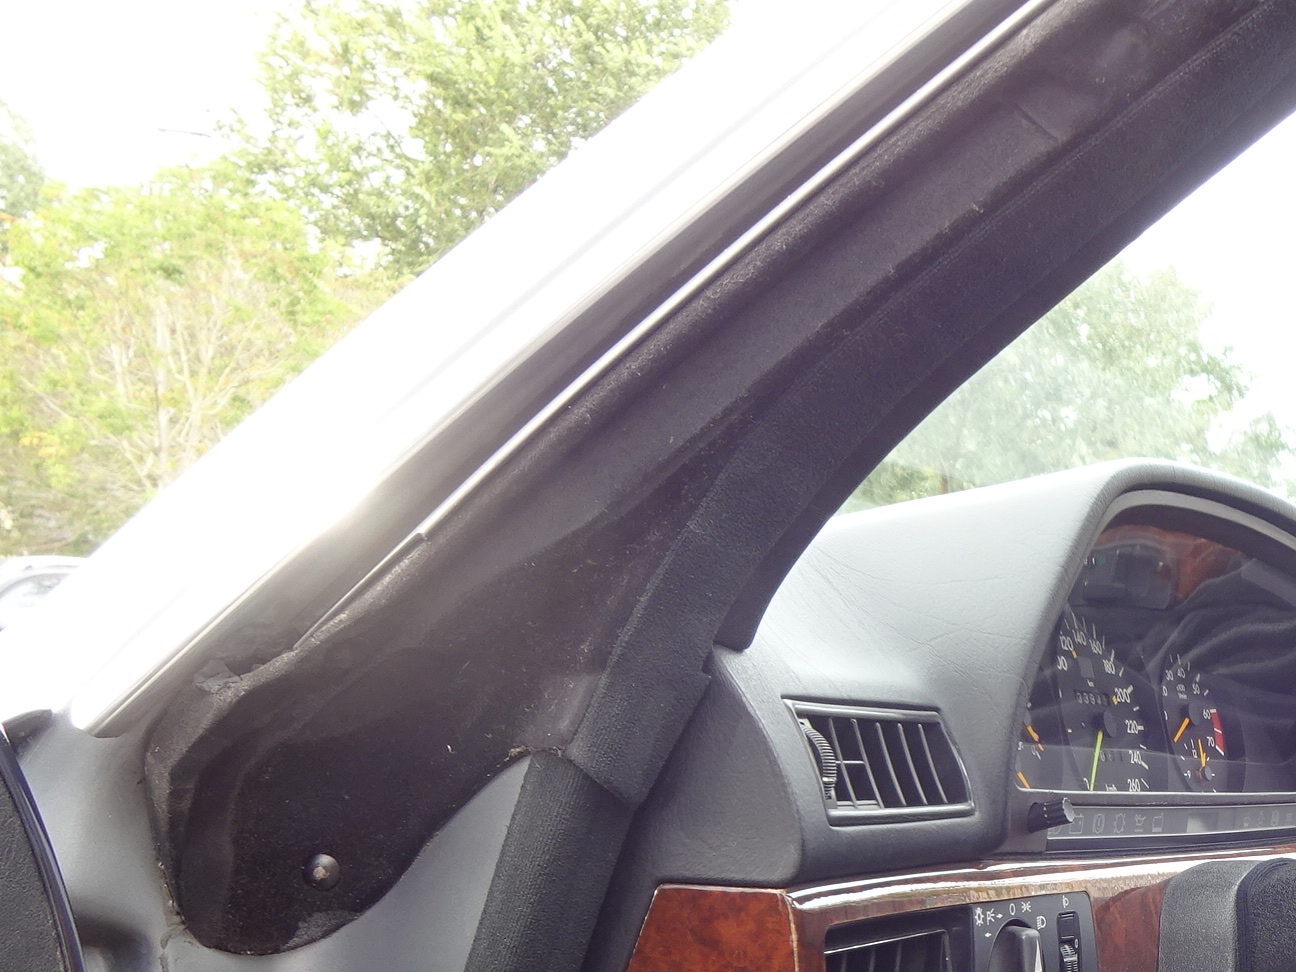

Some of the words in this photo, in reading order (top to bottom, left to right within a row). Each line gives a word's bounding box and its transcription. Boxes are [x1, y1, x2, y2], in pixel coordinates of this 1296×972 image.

[1103, 659, 1116, 675] 180
[1114, 687, 1130, 704] 200
[1192, 683, 1201, 695] 50
[1202, 708, 1211, 720] 60
[1125, 719, 1139, 734] 220
[1206, 736, 1215, 748] 70
[1128, 749, 1142, 765] 240
[1127, 778, 1141, 792] 260
